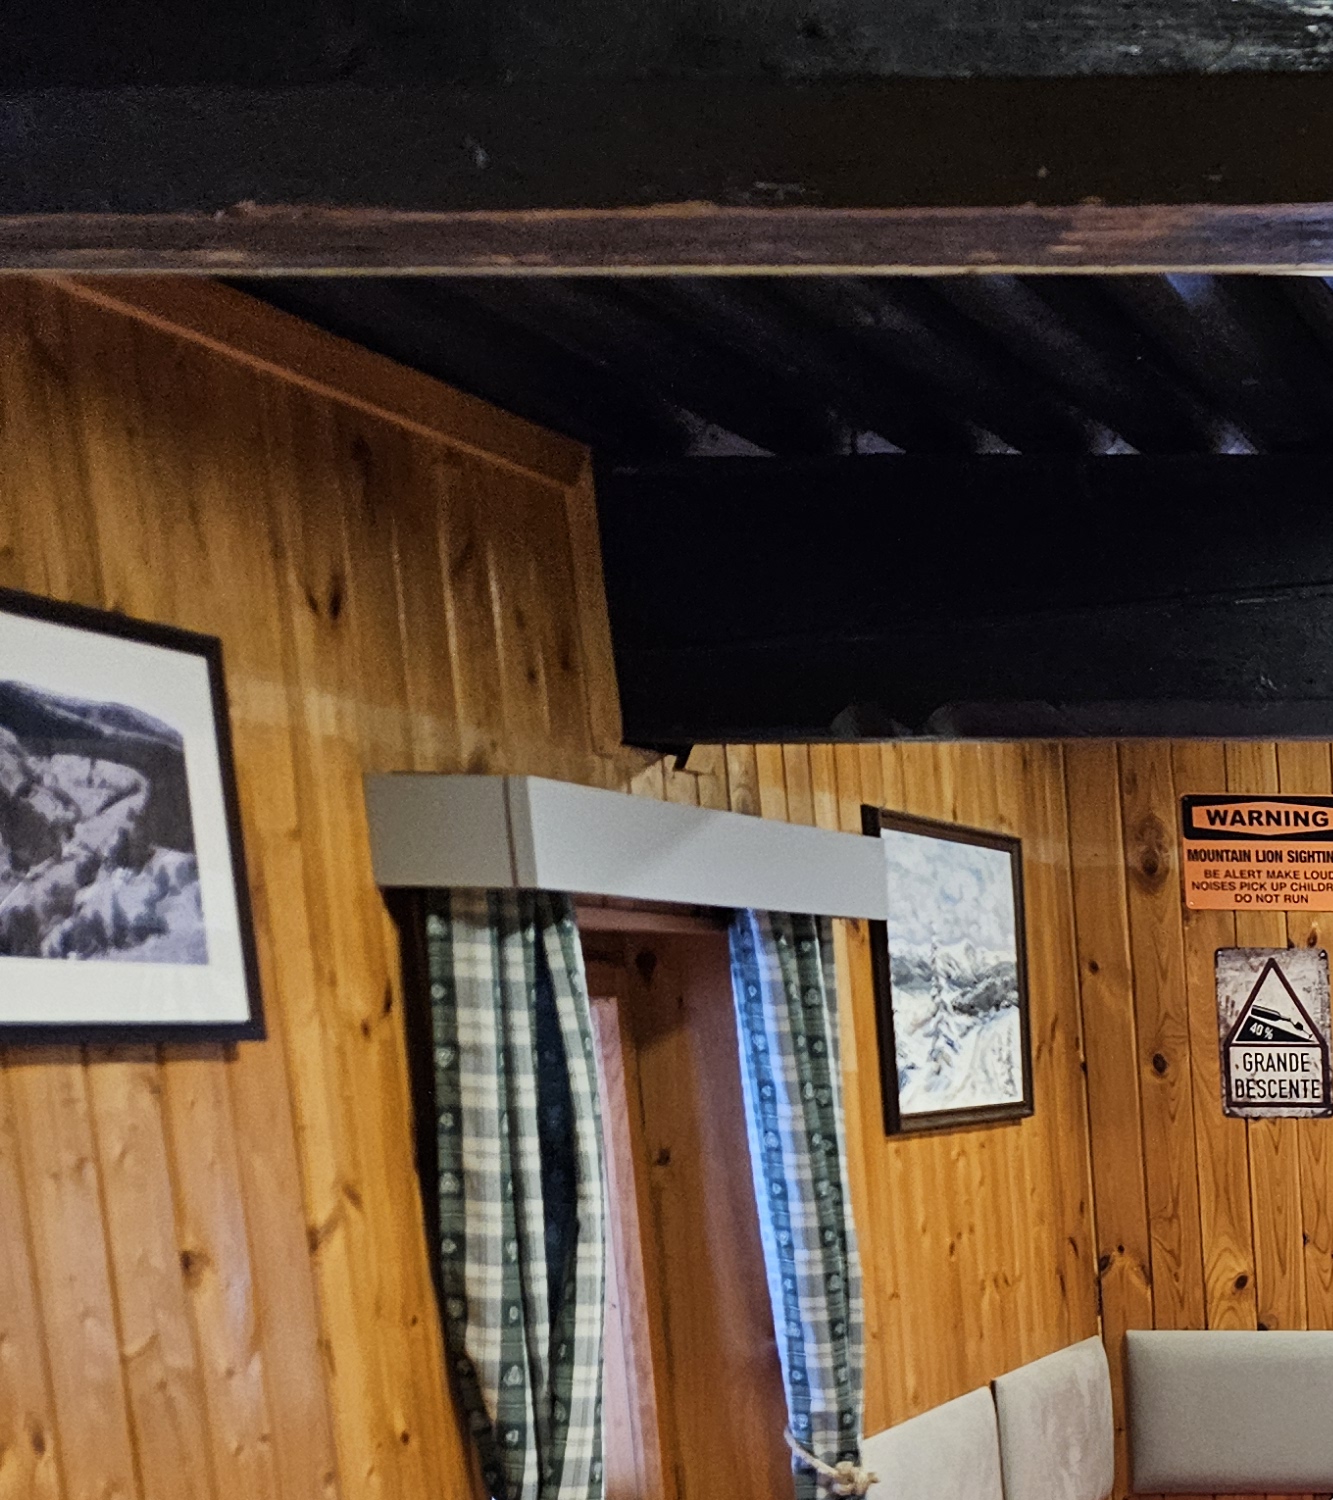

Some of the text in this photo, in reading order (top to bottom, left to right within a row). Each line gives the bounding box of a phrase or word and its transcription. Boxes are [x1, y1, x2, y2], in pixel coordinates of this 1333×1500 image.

[1206, 808, 1330, 828] WARNING
[1187, 849, 1251, 863] MOUNTAIN
[1255, 850, 1283, 863] LION
[1204, 869, 1220, 879] BE
[1224, 869, 1262, 879] ALERT
[1266, 870, 1300, 880] MAKE
[1191, 881, 1236, 891] NOISES
[1239, 882, 1267, 891] PICK
[1271, 882, 1286, 891] UP
[1234, 894, 1309, 903] DO NOT RUN
[1242, 1052, 1310, 1072] GRANDE
[1234, 1077, 1321, 1100] DESCENTE
